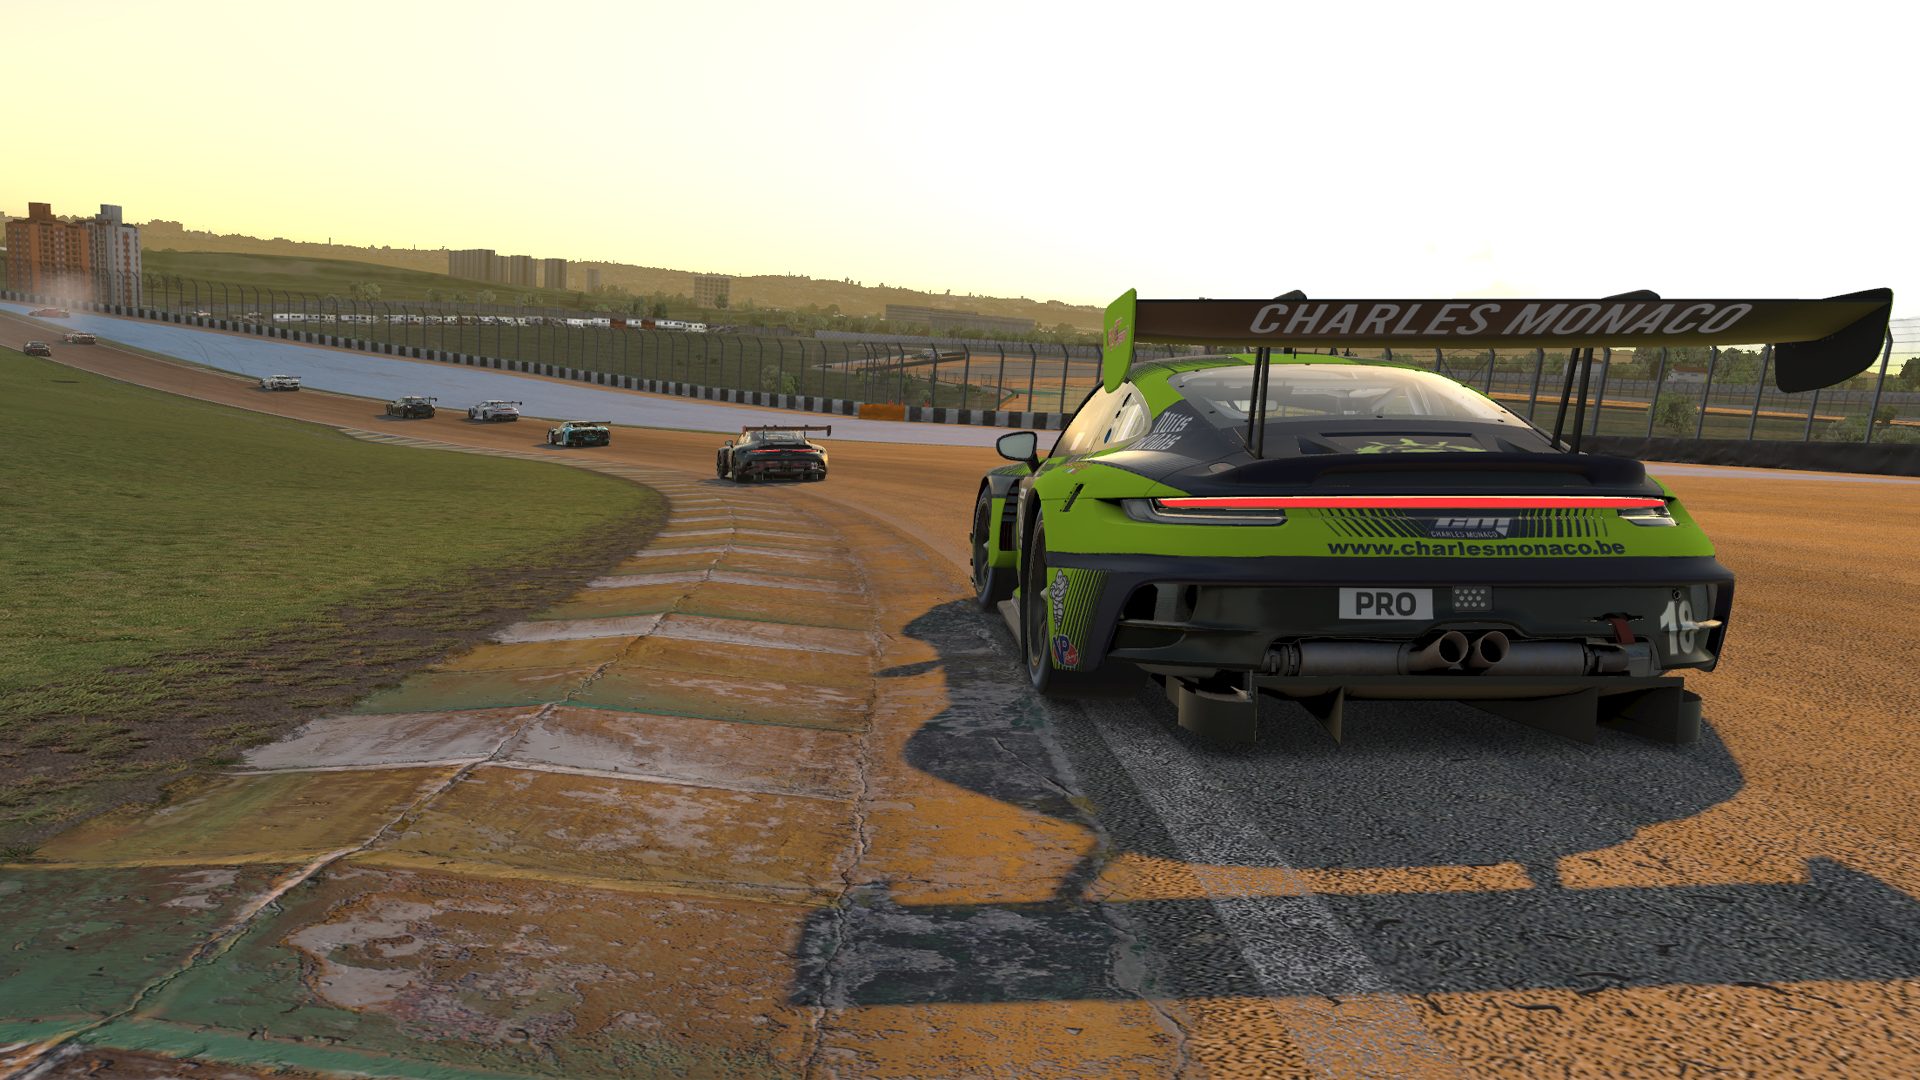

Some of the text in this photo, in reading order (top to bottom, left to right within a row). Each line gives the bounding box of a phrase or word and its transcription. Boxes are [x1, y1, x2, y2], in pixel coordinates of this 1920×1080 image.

[1249, 303, 1753, 335] CHARLES MONACO
[1431, 530, 1498, 538] CHARLES MONACO
[1328, 540, 1626, 557] www.charlesmonaco.be
[1355, 591, 1417, 617] PRO
[1660, 600, 1695, 655] 18
